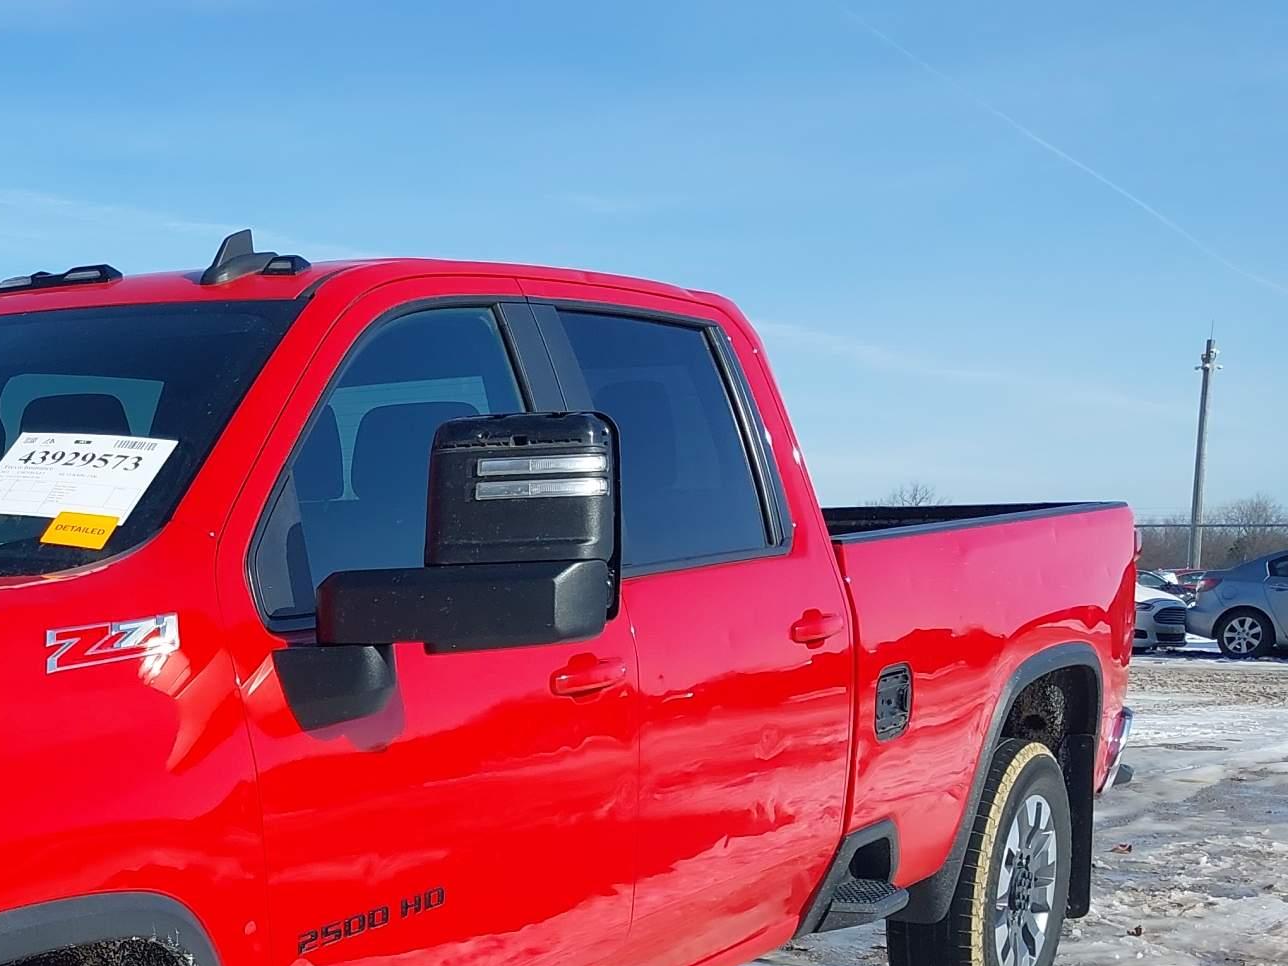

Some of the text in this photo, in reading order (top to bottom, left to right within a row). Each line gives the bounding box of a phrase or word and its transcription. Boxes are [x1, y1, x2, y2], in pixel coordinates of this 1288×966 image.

[17, 449, 143, 472] 43929573
[53, 523, 106, 536] DETAILED
[45, 612, 180, 675] Z71
[297, 886, 446, 955] 2500 HD
